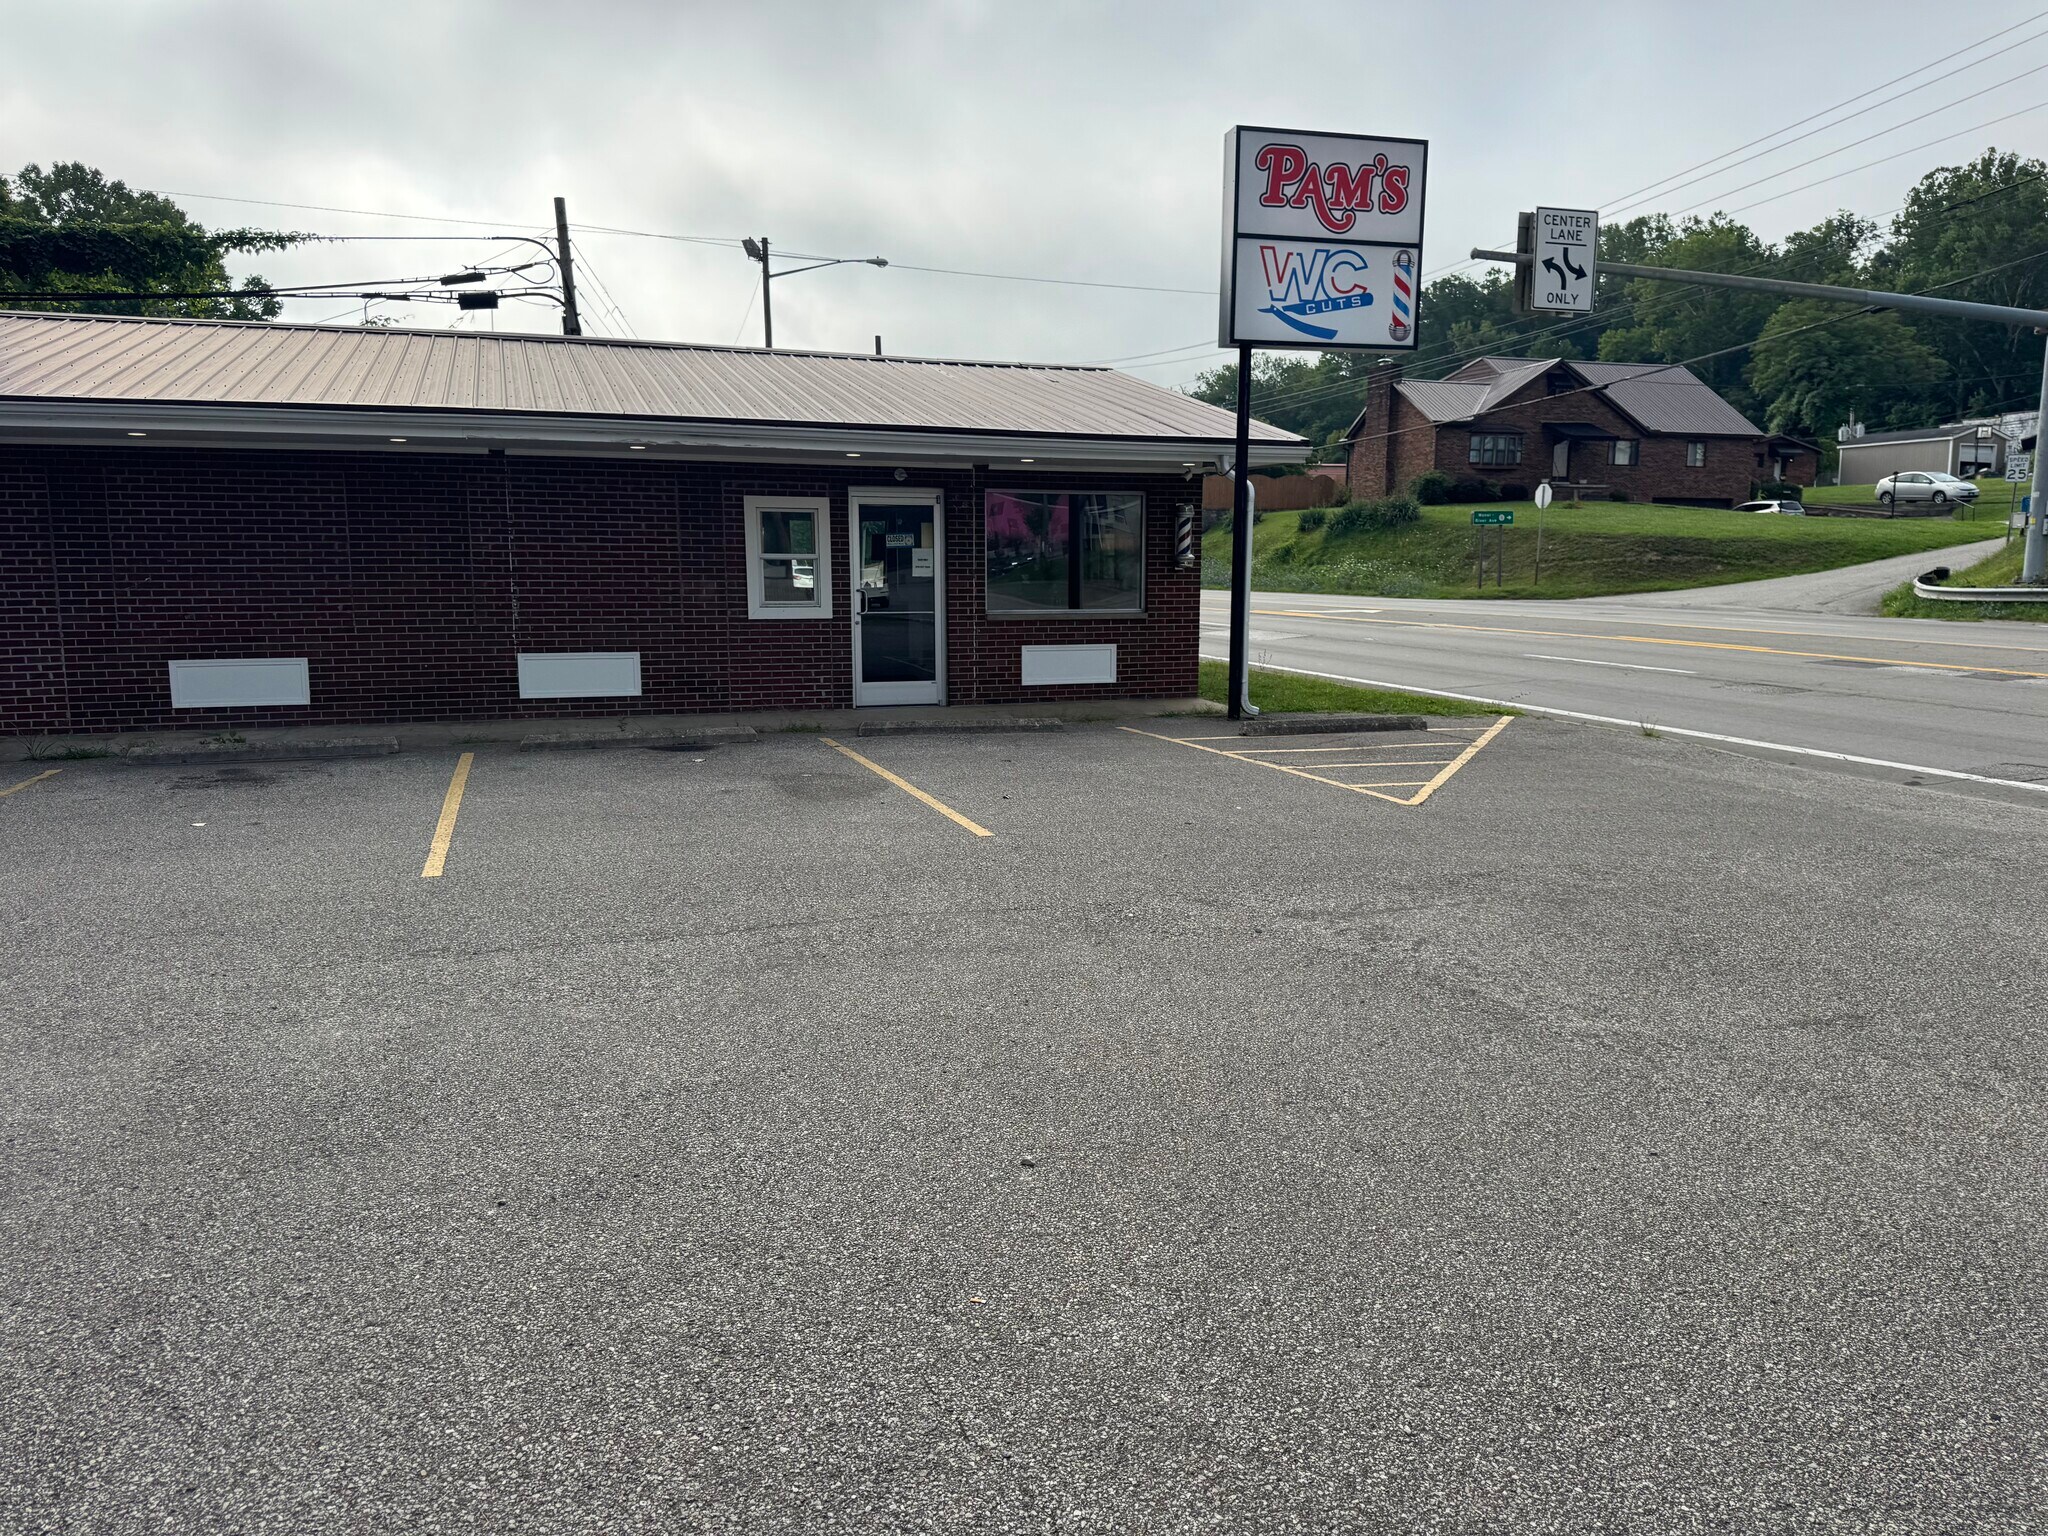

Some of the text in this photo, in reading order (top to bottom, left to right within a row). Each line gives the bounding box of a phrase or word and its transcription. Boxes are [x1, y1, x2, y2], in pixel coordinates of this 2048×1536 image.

[1255, 143, 1410, 234] PAM'S
[1544, 214, 1591, 228] CENTER
[1551, 228, 1583, 241] LANE
[1260, 245, 1368, 302] WC
[1306, 297, 1361, 314] CUTS
[1547, 292, 1579, 305] ONLY
[2007, 469, 2027, 479] 25
